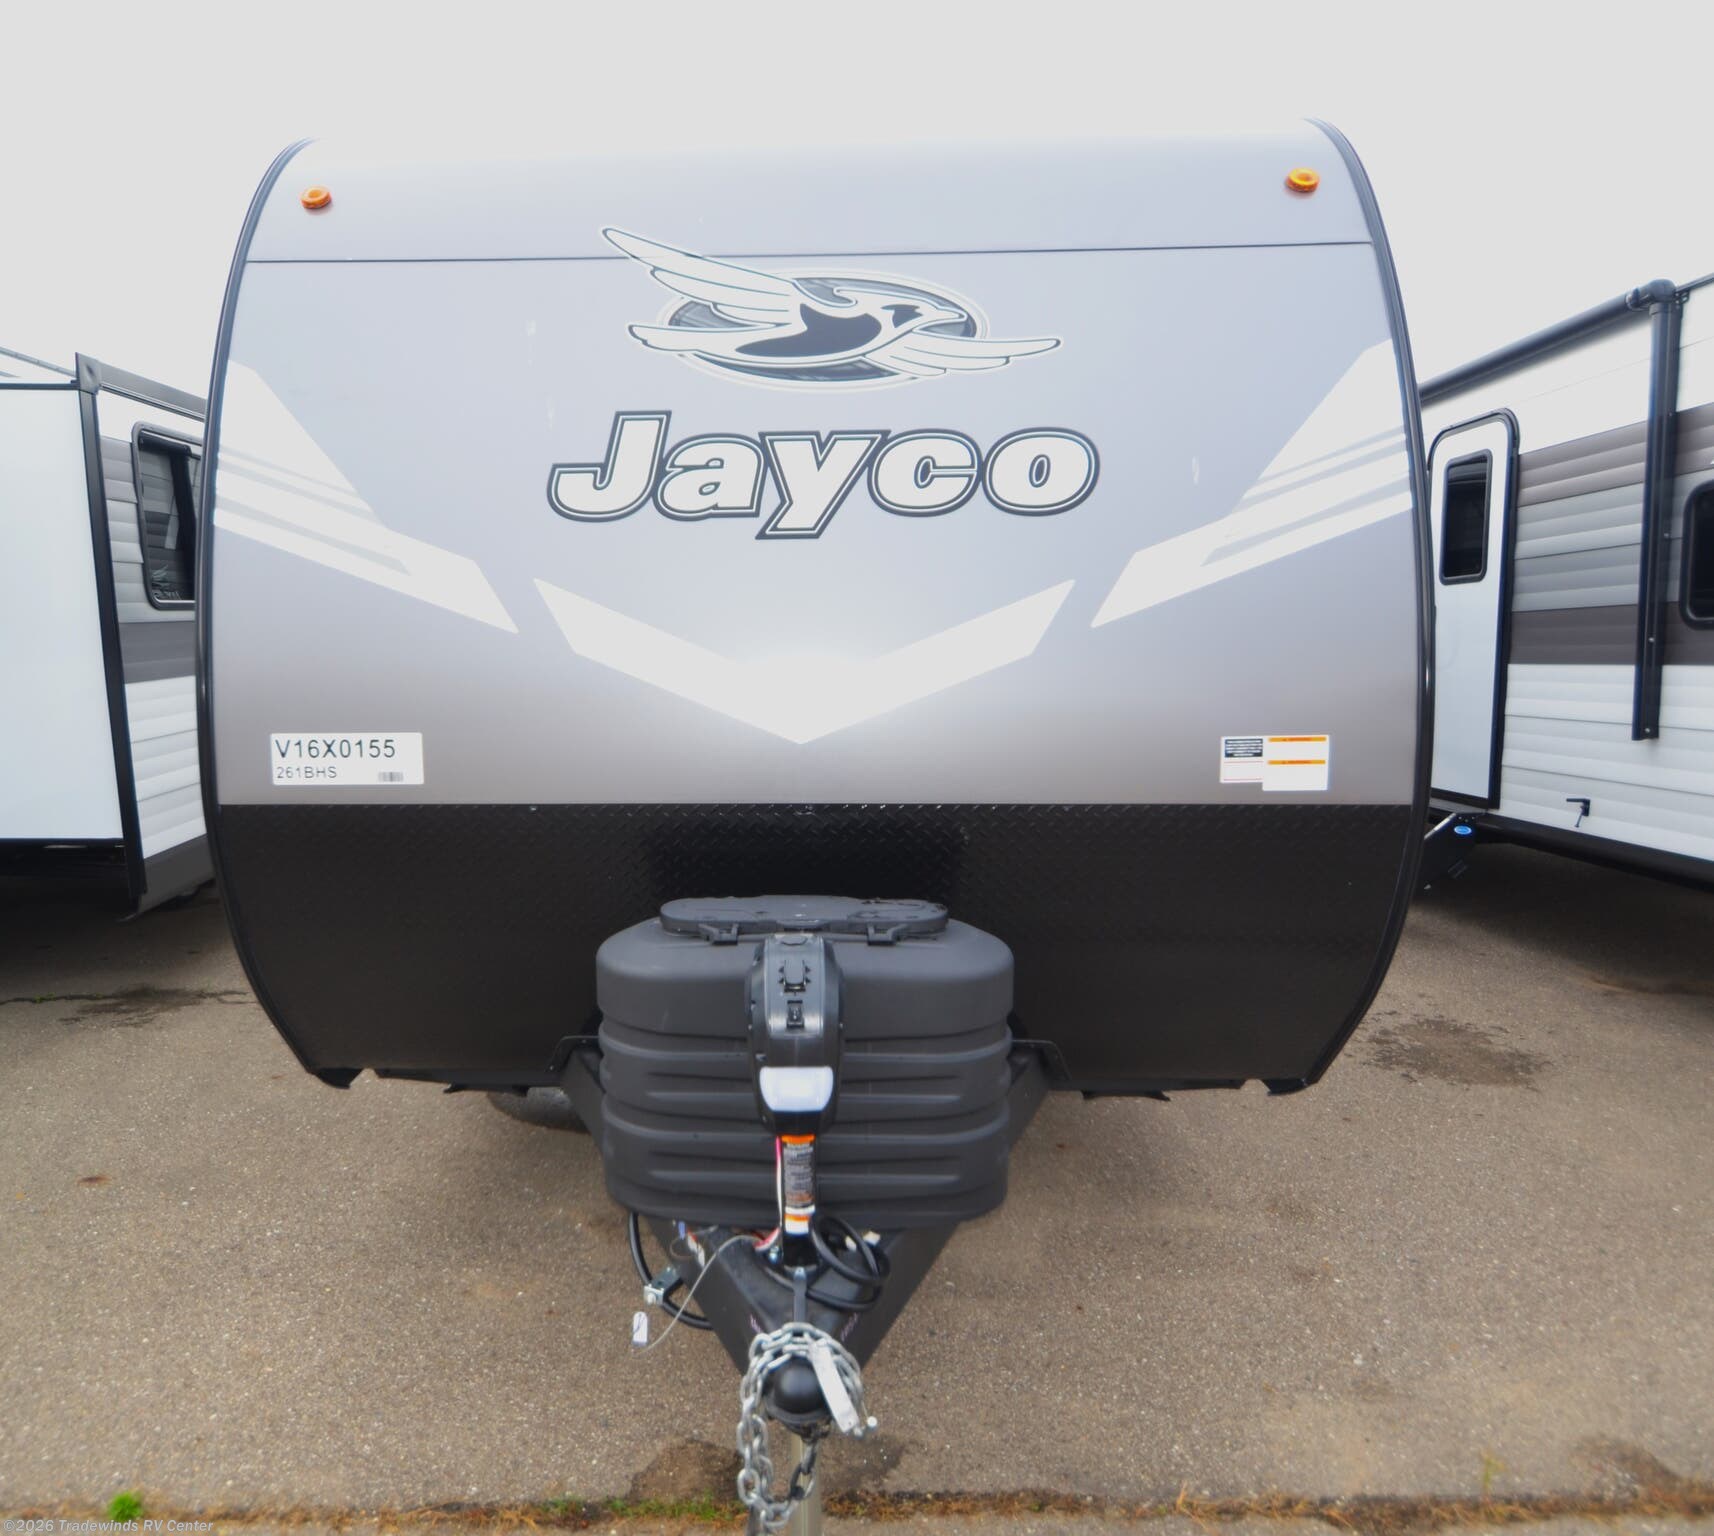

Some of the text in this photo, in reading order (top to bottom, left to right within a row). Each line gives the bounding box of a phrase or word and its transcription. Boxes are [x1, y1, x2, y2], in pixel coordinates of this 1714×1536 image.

[546, 410, 1101, 540] Jayco
[275, 739, 396, 759] V16X0155
[276, 766, 338, 779] 261BHS
